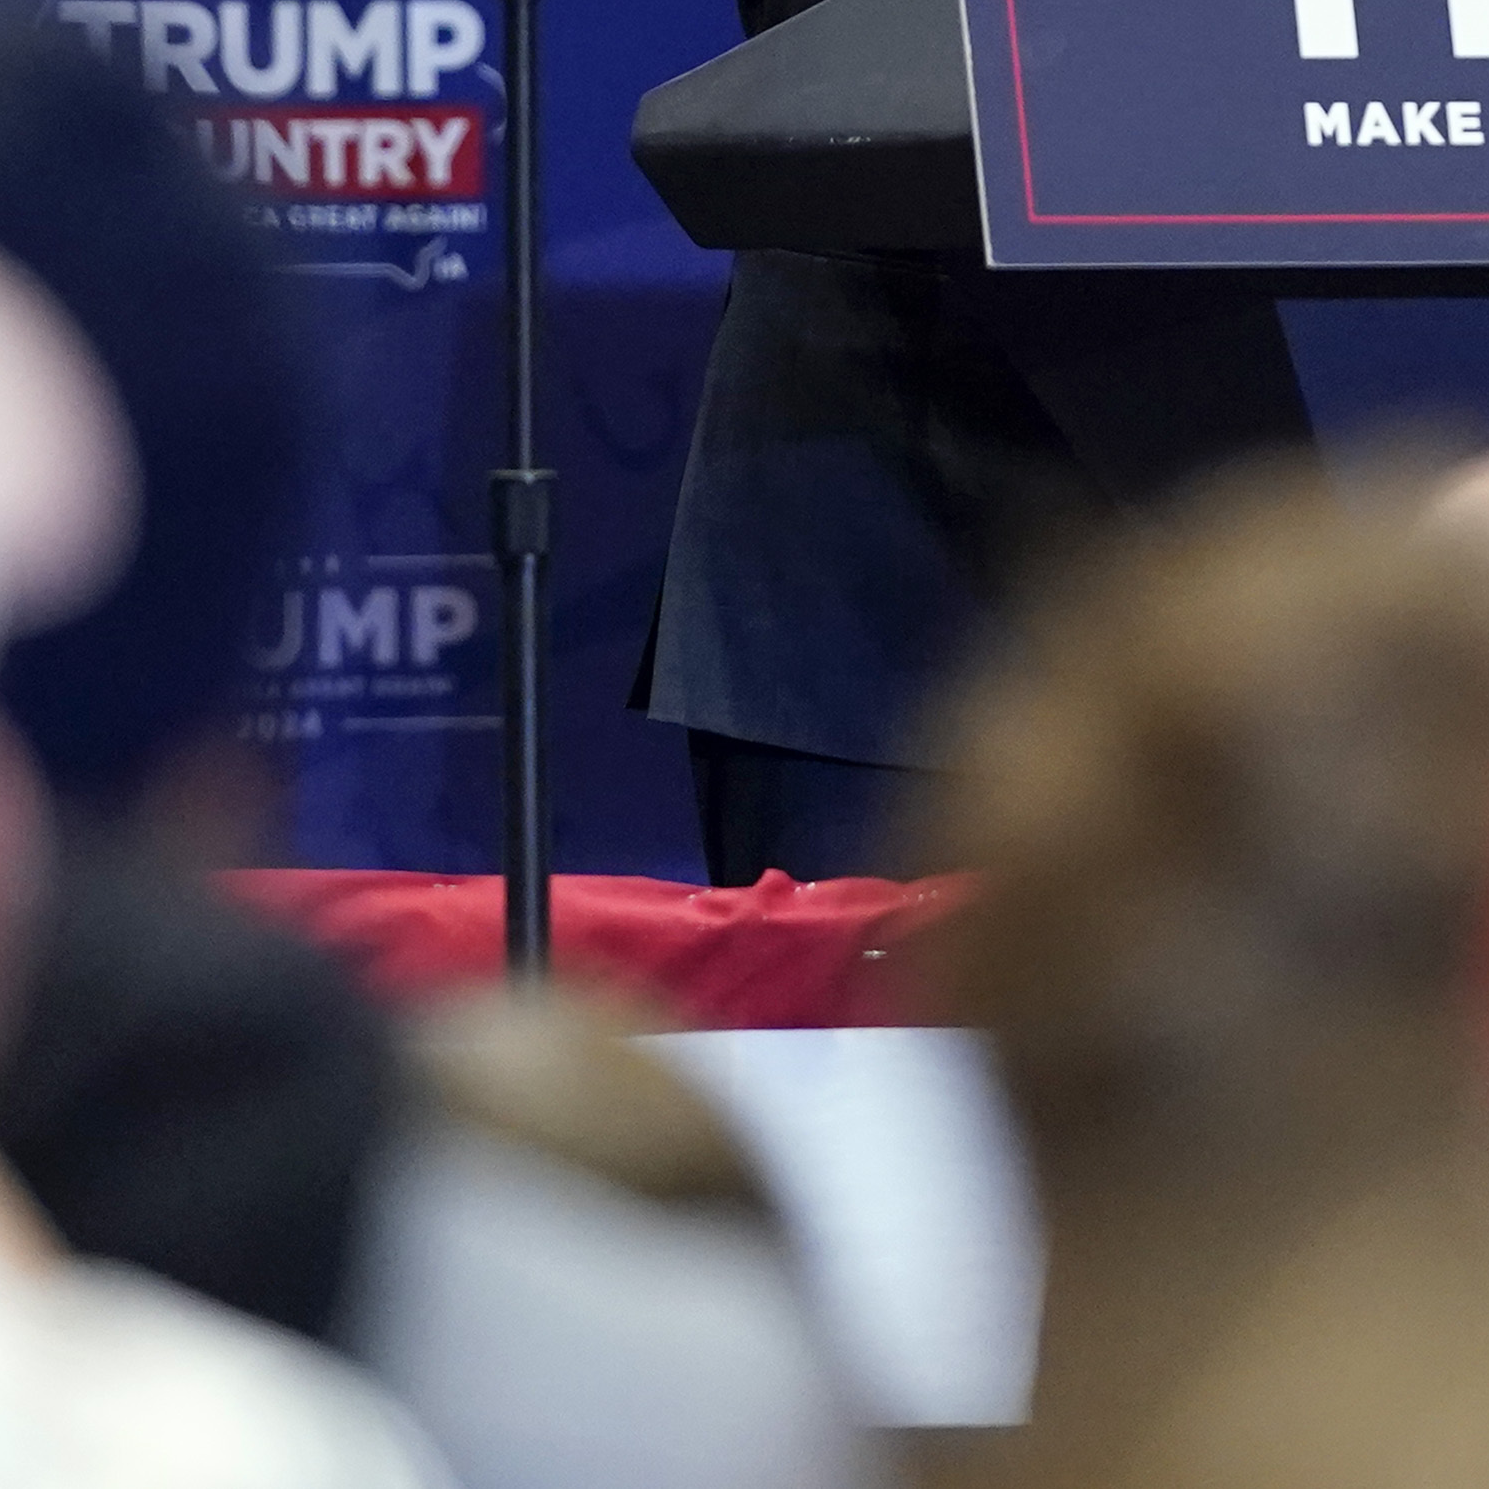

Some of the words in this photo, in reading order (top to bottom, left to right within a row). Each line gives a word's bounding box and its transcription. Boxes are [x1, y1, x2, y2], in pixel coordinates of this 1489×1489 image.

[191, 116, 473, 190] UNTRY
[1303, 100, 1487, 147] MAKE
[247, 585, 480, 669] UMP
